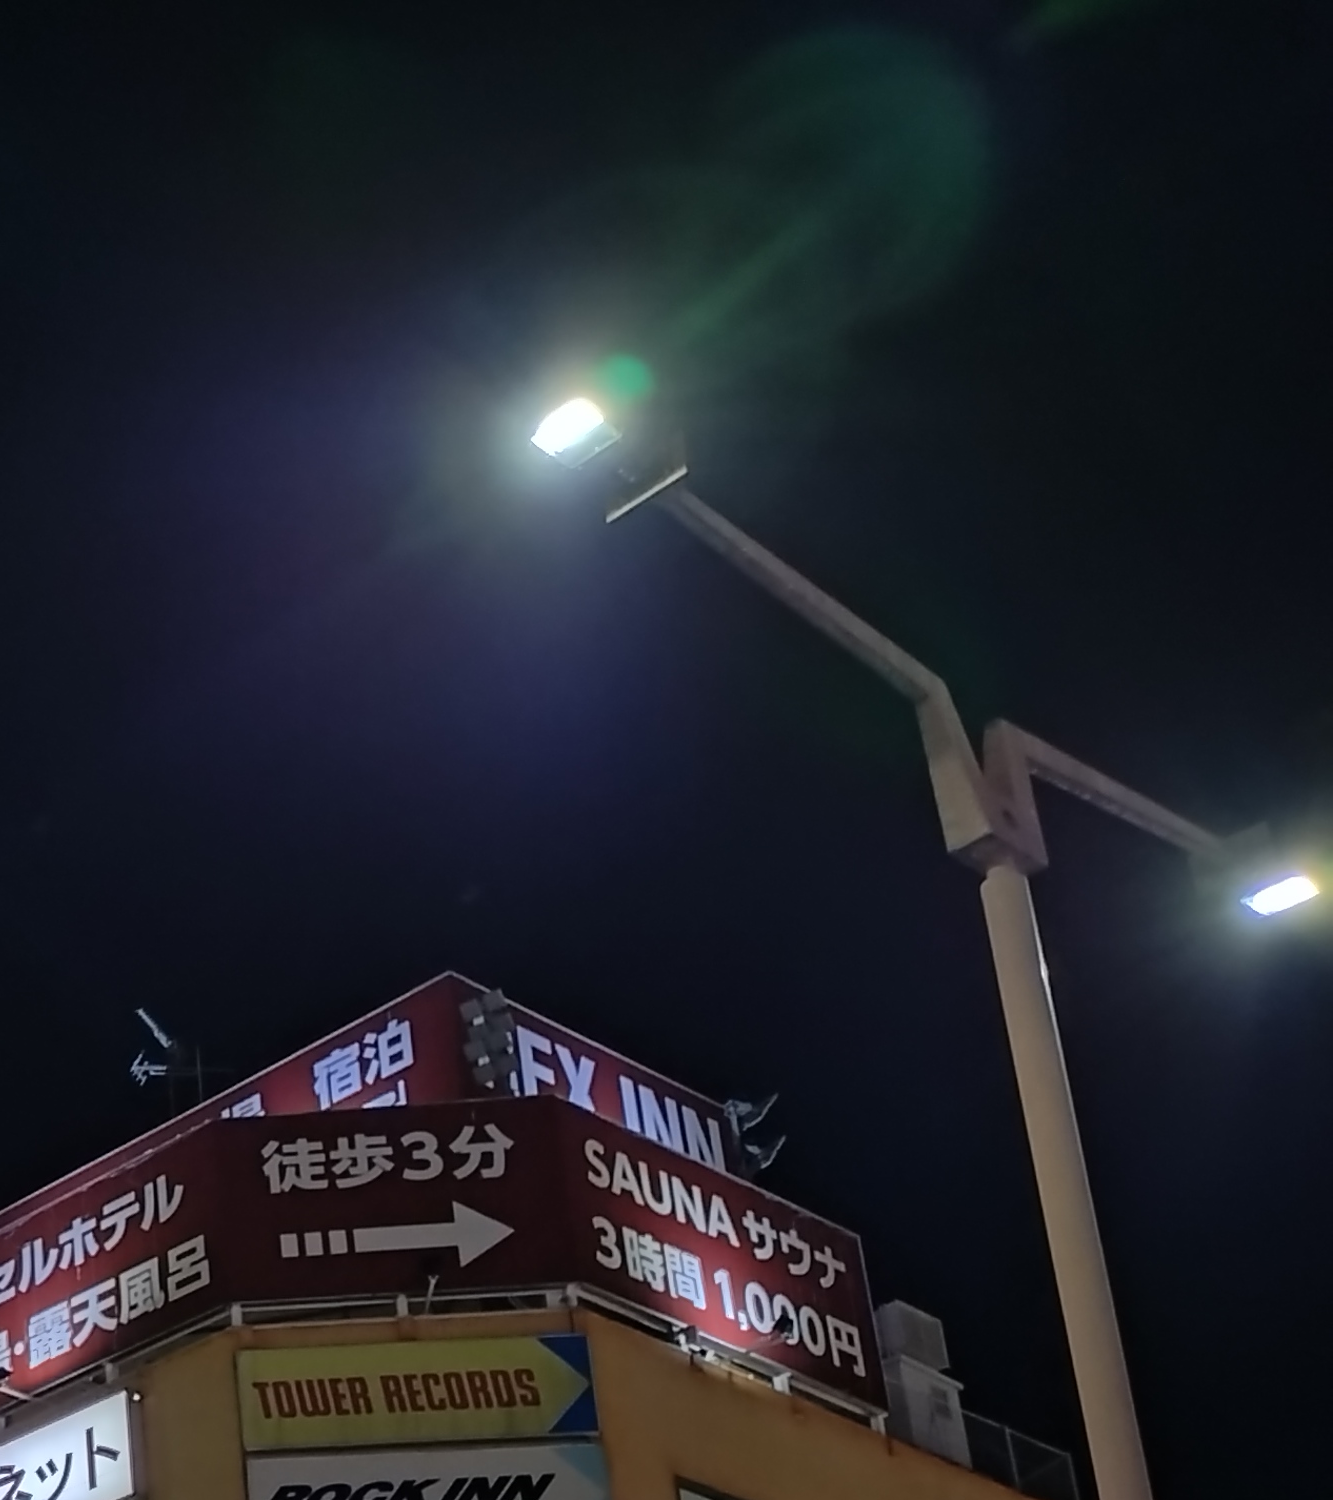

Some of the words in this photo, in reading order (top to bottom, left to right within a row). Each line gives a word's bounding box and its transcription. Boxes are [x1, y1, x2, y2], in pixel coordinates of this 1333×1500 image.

[311, 1017, 416, 1110] 宿泊
[260, 1122, 515, 1194] 徒歩3分
[583, 1137, 740, 1249] SAUNA
[740, 1209, 848, 1289] サウナ
[591, 1215, 708, 1312] 3時間
[711, 1268, 868, 1379] 1,000円
[251, 1376, 374, 1419] TOWER
[379, 1367, 541, 1414] RECORDS
